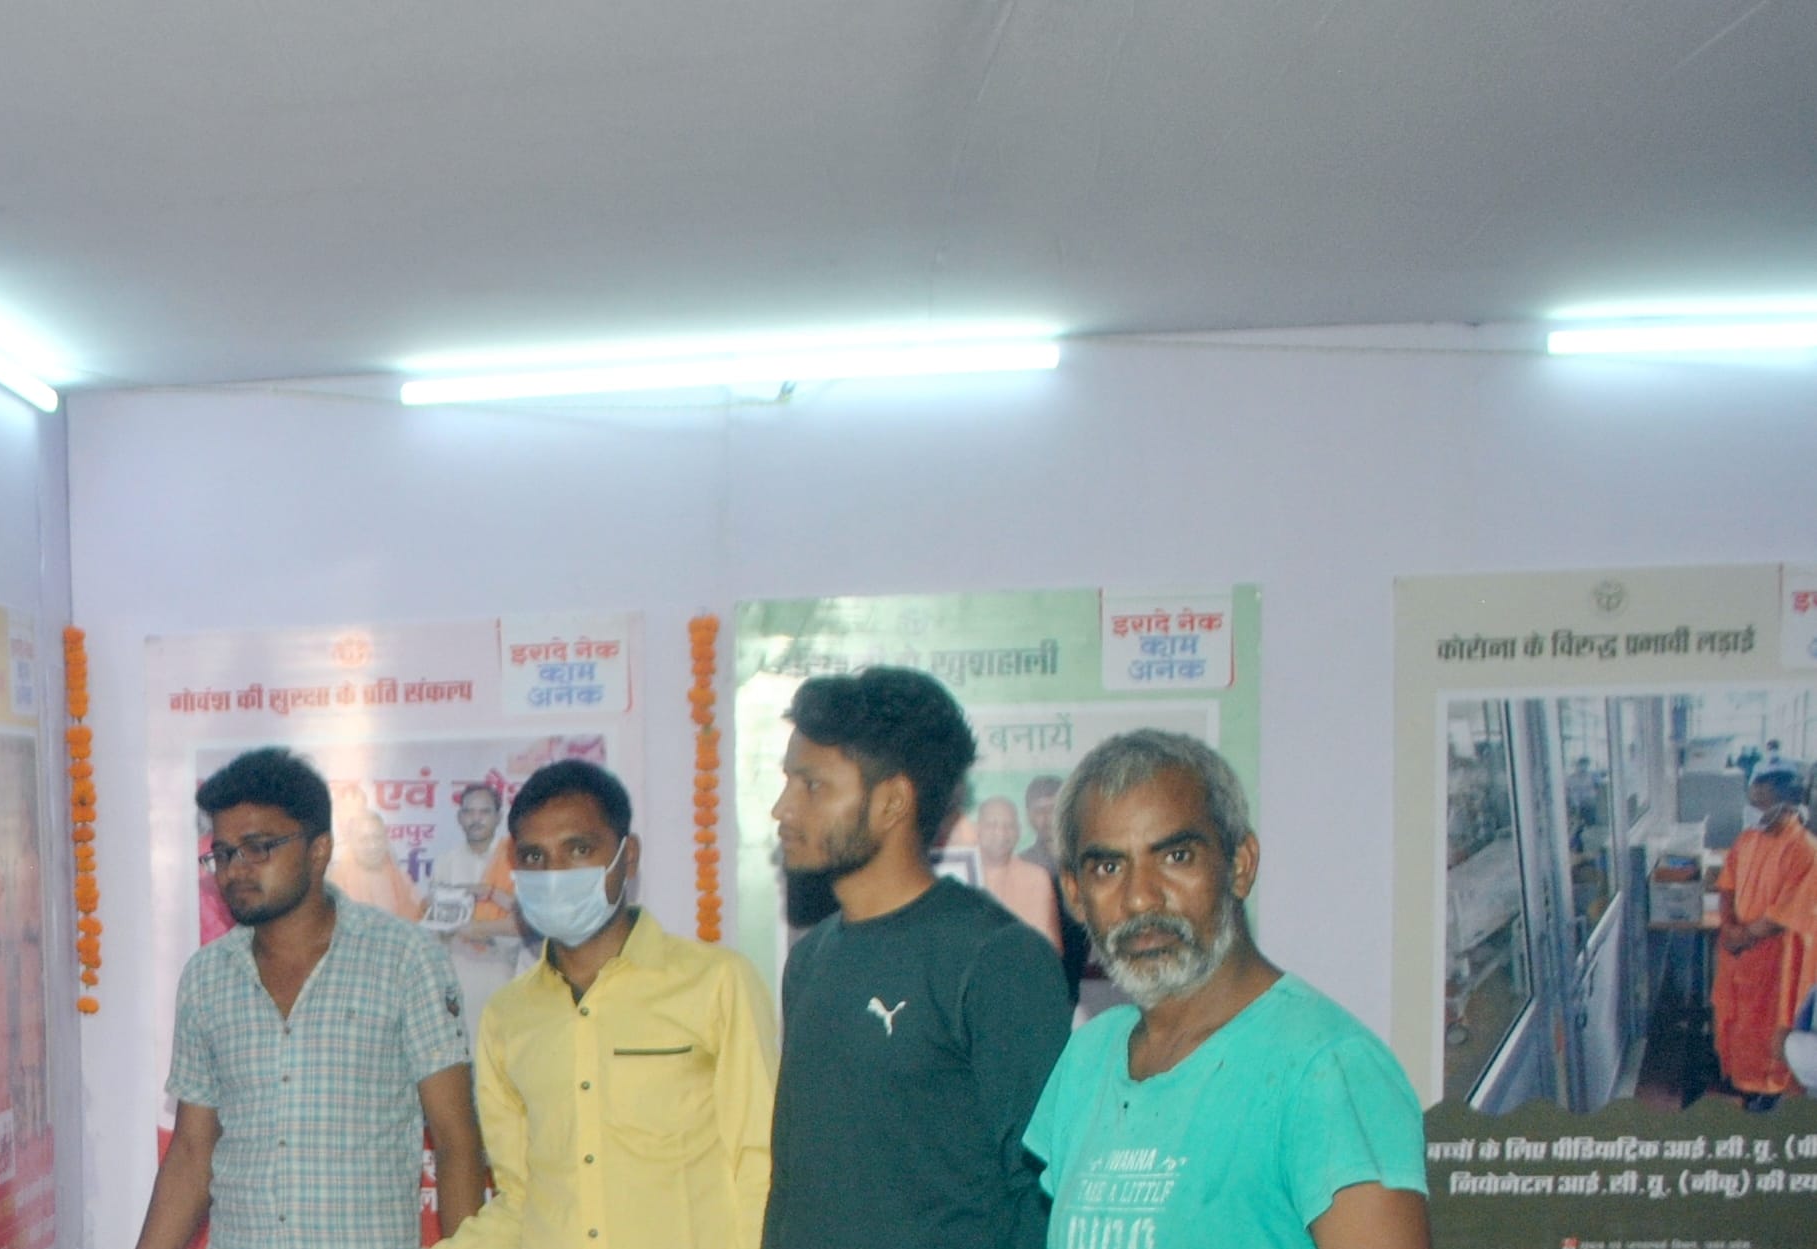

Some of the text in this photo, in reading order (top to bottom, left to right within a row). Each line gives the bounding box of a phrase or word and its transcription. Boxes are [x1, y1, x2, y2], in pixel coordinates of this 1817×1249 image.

[1110, 606, 1224, 638] इरादे नेक
[509, 635, 621, 666] इरादे नेक
[1139, 634, 1200, 656] काम
[1437, 624, 1756, 662] कोरोना के विरुद्ध प्रभावी लड़ाई
[537, 661, 597, 682] काम
[1128, 656, 1207, 683] अनेक
[237, 682, 264, 711] की
[335, 680, 357, 706] के
[403, 677, 474, 705] संकल्प
[527, 679, 605, 707] अनेक
[373, 766, 439, 810] एवं
